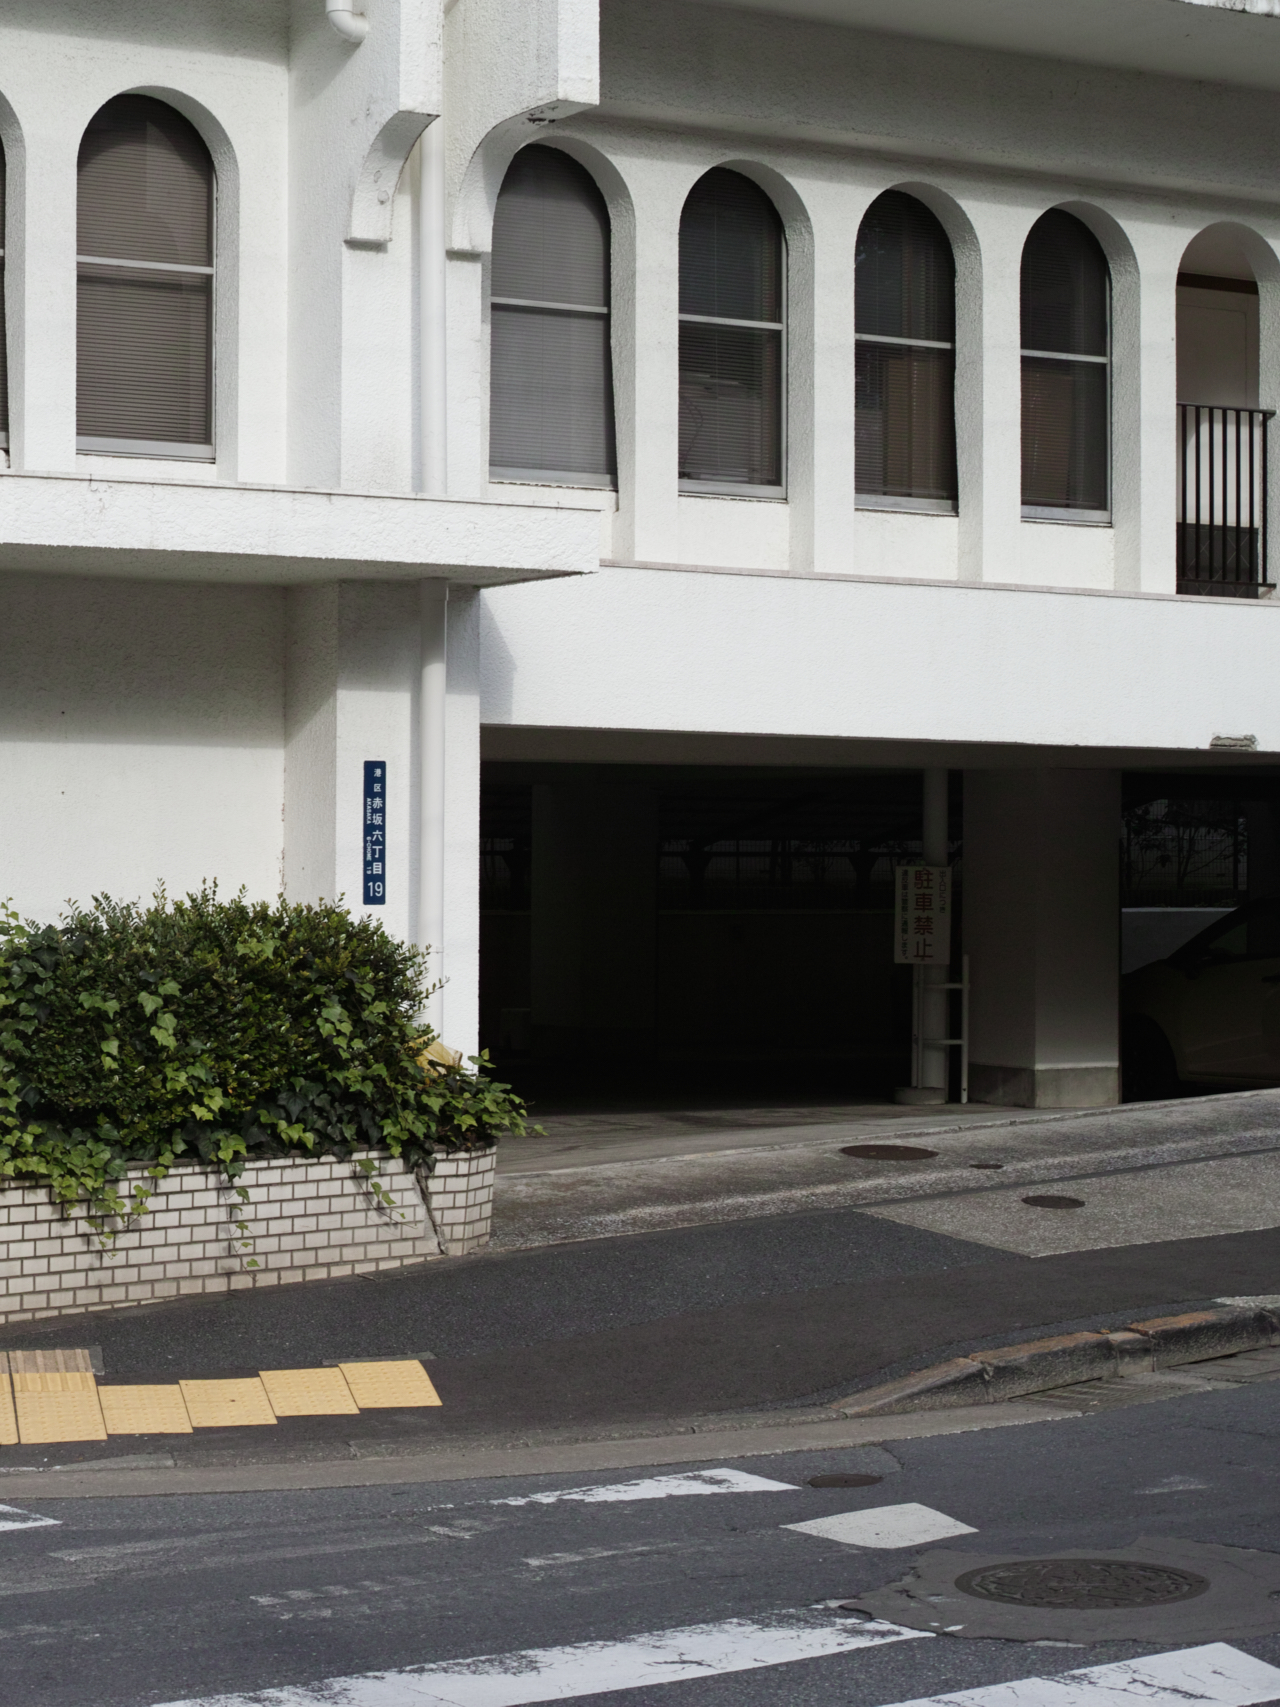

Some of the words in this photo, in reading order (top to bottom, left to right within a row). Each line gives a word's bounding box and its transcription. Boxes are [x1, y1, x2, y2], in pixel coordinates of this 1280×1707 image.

[366, 866, 372, 875] 19
[913, 869, 934, 958] 駐車禁止
